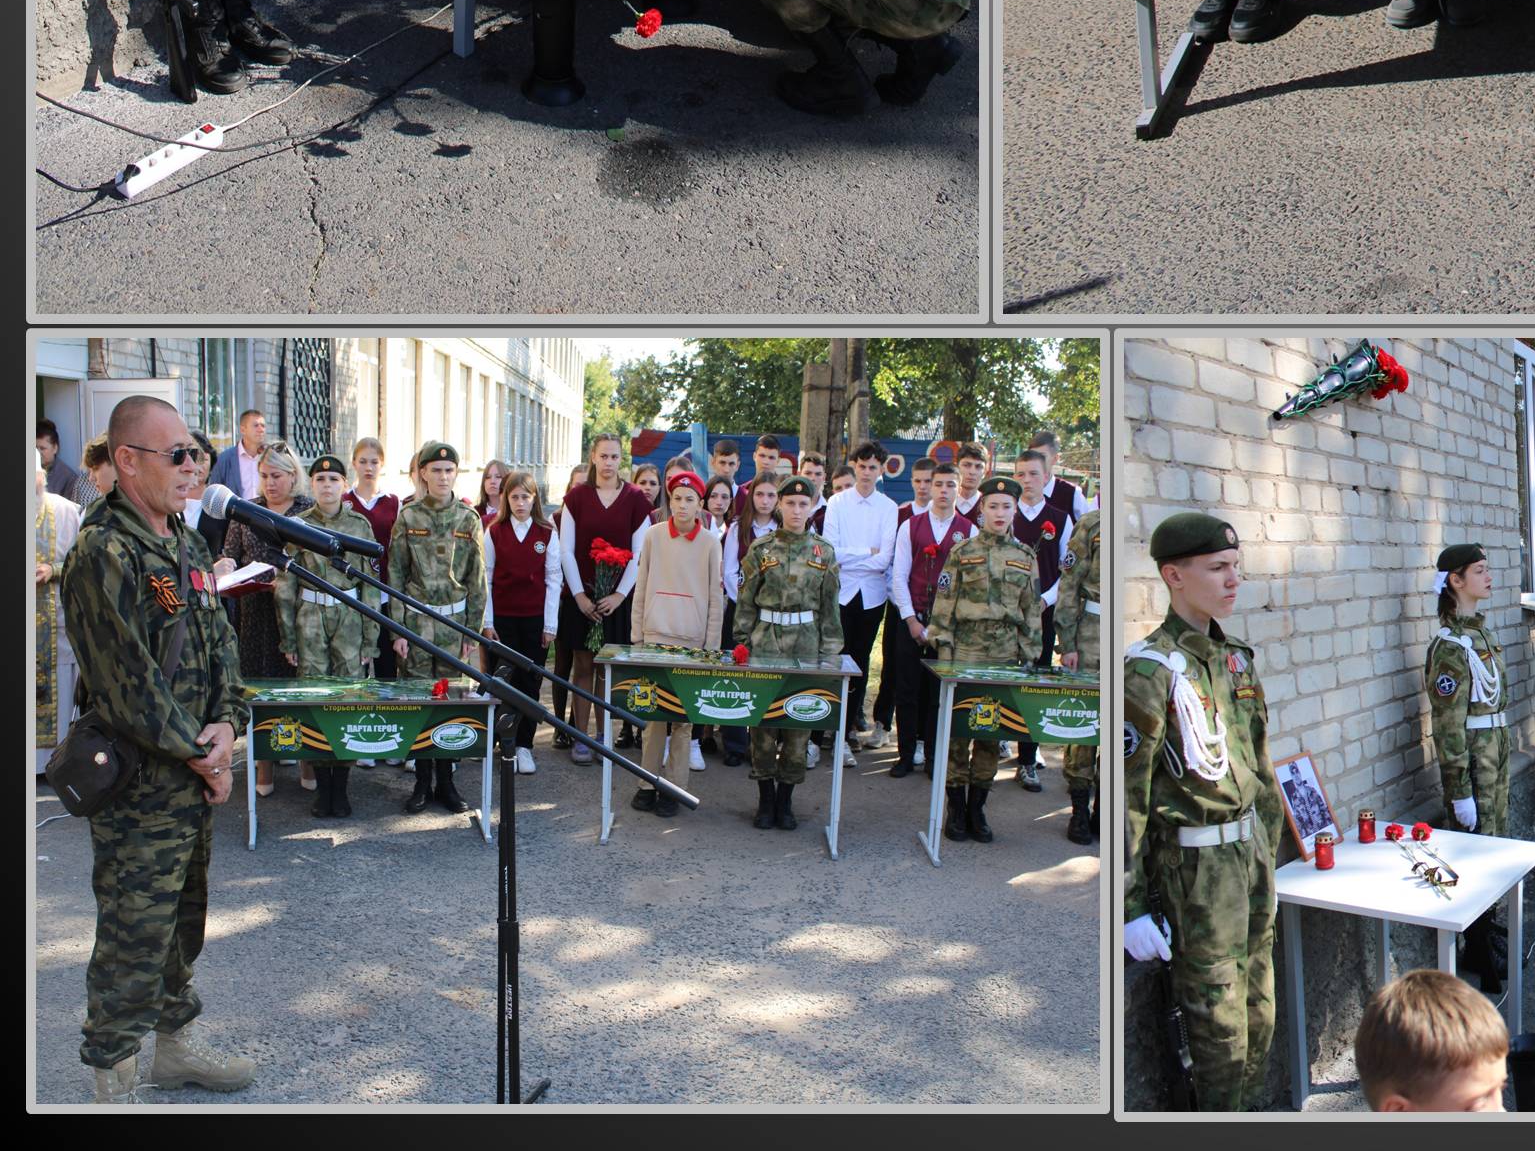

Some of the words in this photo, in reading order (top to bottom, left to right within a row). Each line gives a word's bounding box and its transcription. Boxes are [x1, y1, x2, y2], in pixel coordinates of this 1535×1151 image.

[745, 671, 782, 680] Павлович
[701, 689, 726, 698] ПАРТА
[727, 690, 750, 699] ГЕРОЯ
[1046, 708, 1071, 717] ПАРТА
[1073, 710, 1097, 719] ГЕРОЯ
[347, 724, 372, 733] ПАРТА
[373, 724, 398, 732] ГЕРОЯ
